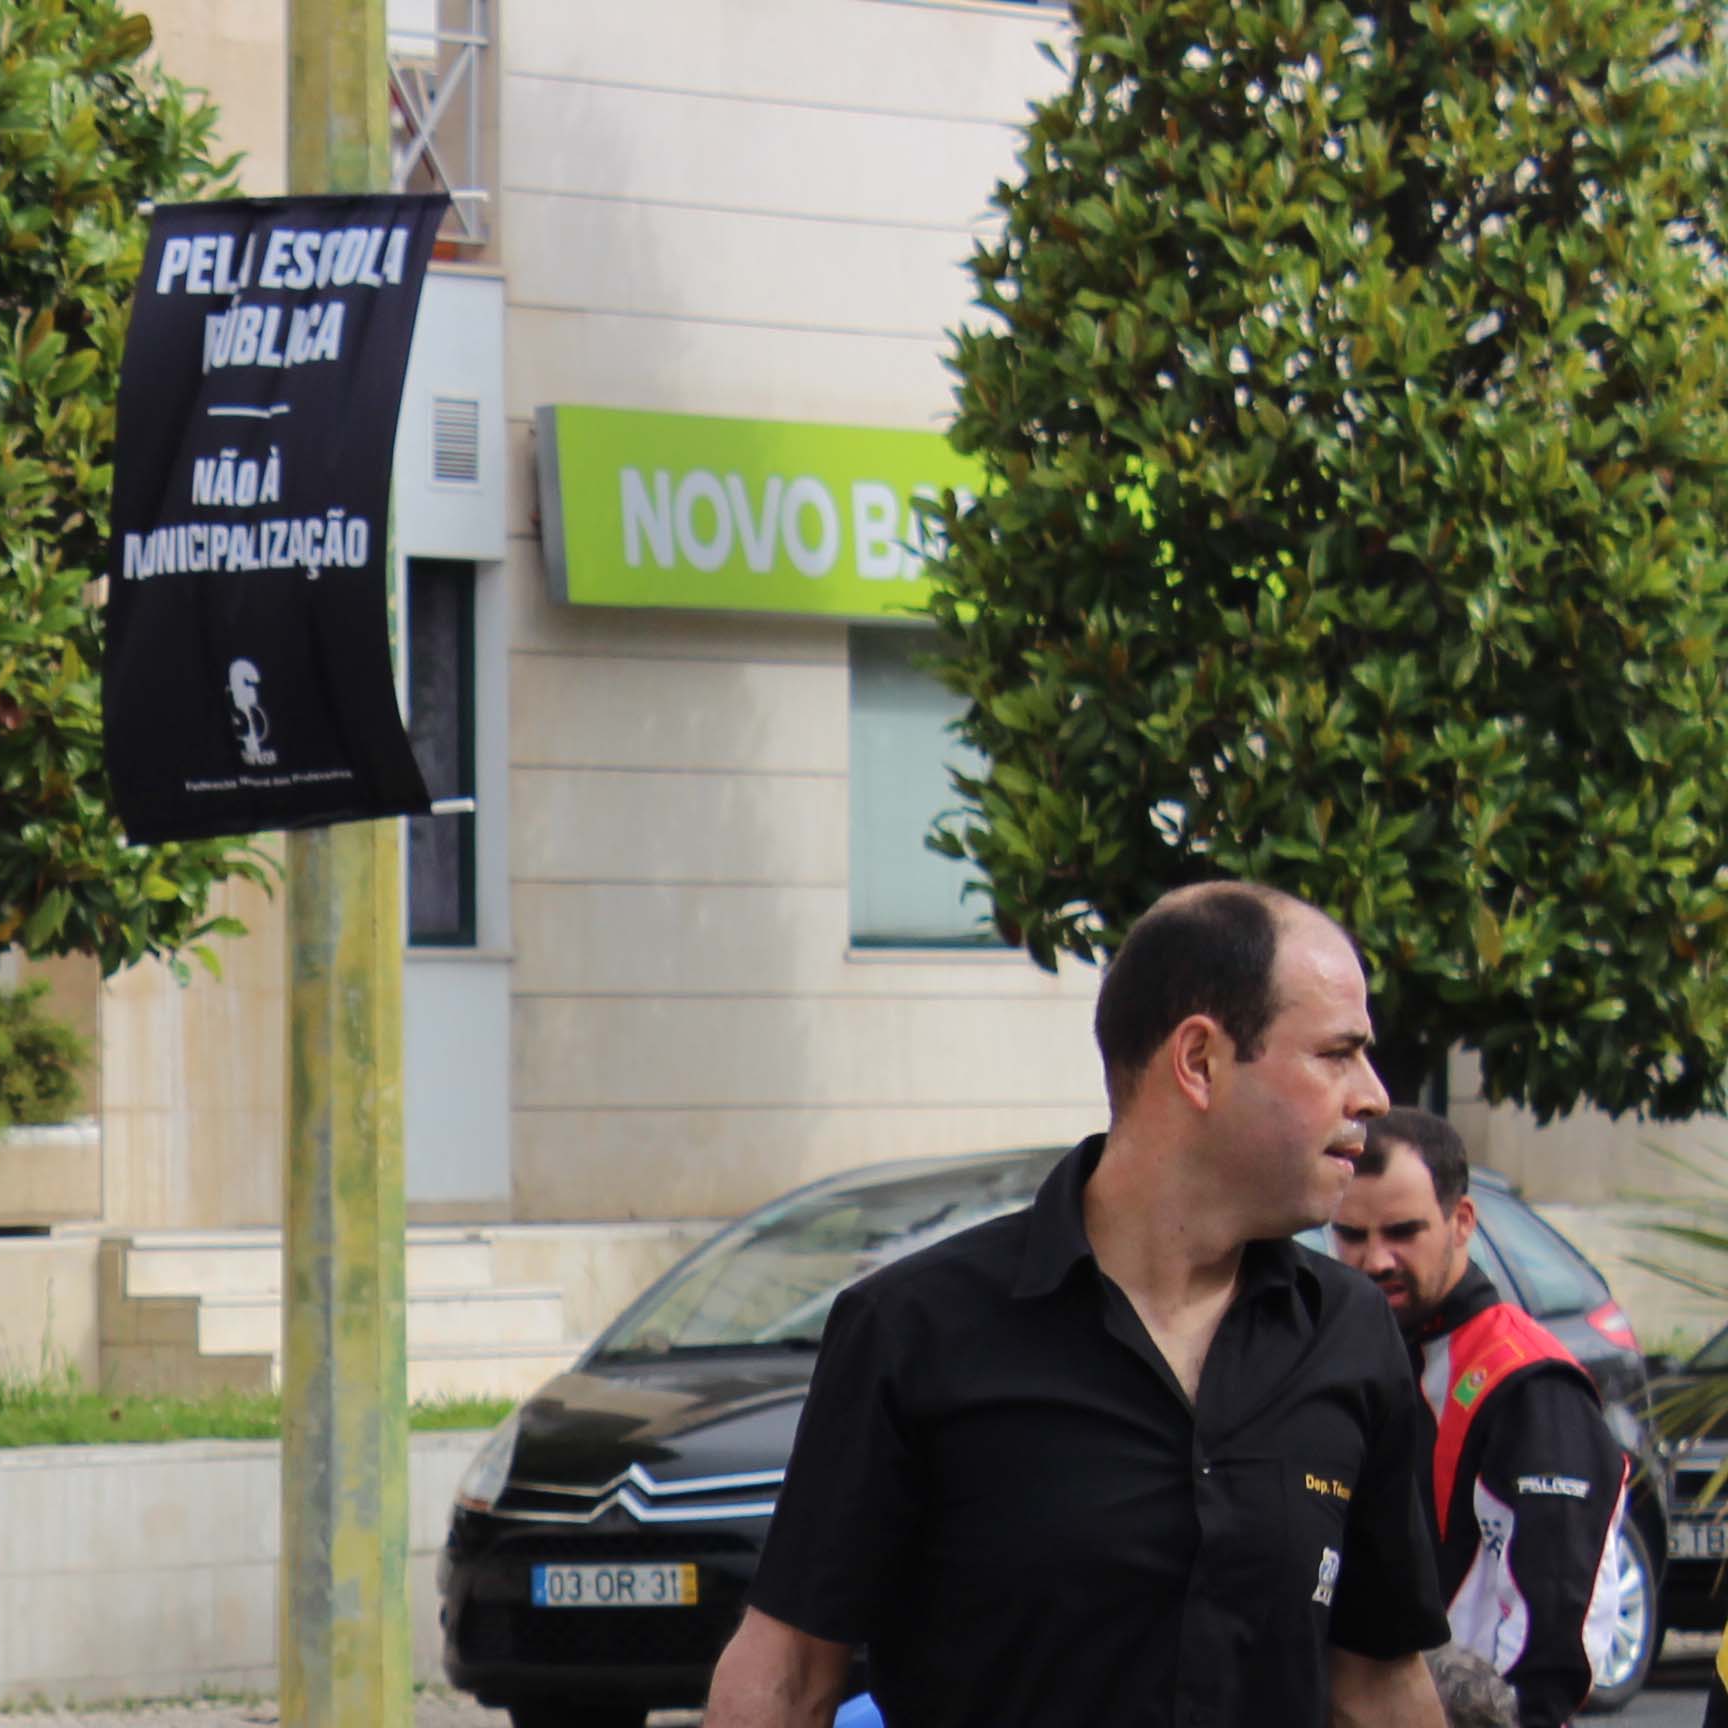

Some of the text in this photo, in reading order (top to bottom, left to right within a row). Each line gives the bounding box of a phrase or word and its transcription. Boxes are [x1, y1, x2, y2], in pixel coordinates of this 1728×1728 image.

[192, 445, 280, 507] NÃO À
[620, 465, 840, 578] NOVO
